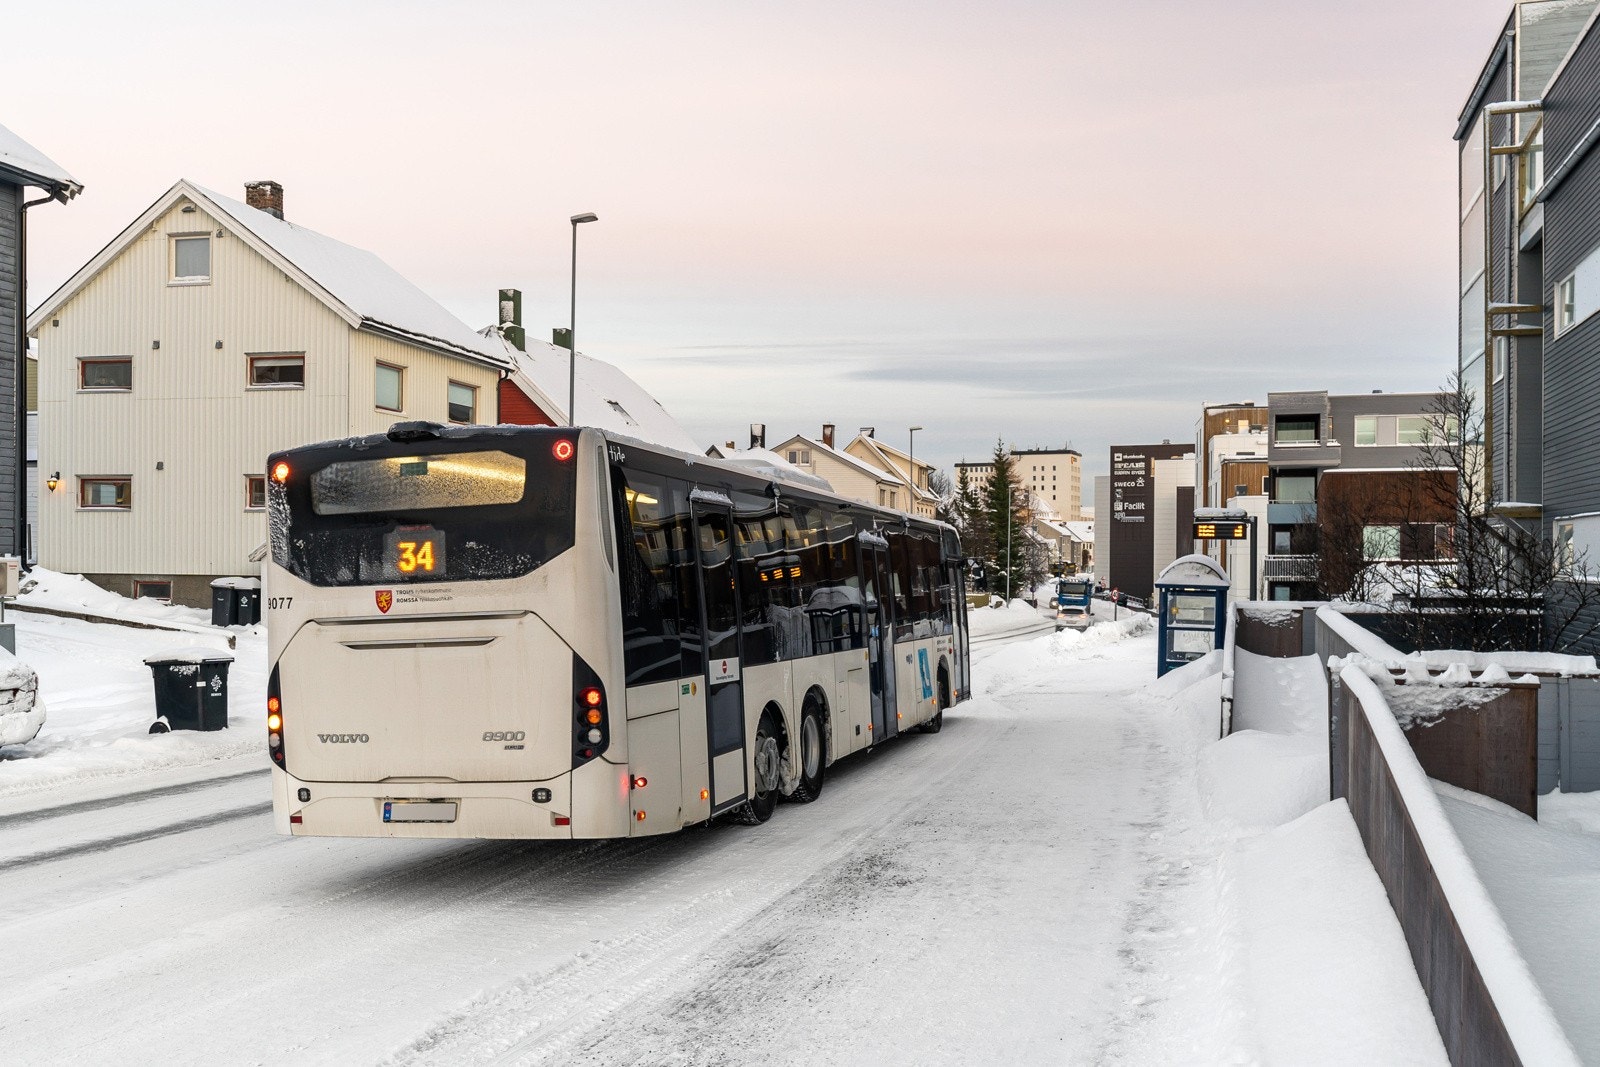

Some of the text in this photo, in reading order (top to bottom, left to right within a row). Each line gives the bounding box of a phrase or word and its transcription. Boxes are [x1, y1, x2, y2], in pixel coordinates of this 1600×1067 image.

[398, 541, 434, 572] 34
[317, 733, 370, 744] VOLVO
[482, 730, 526, 742] 8900
